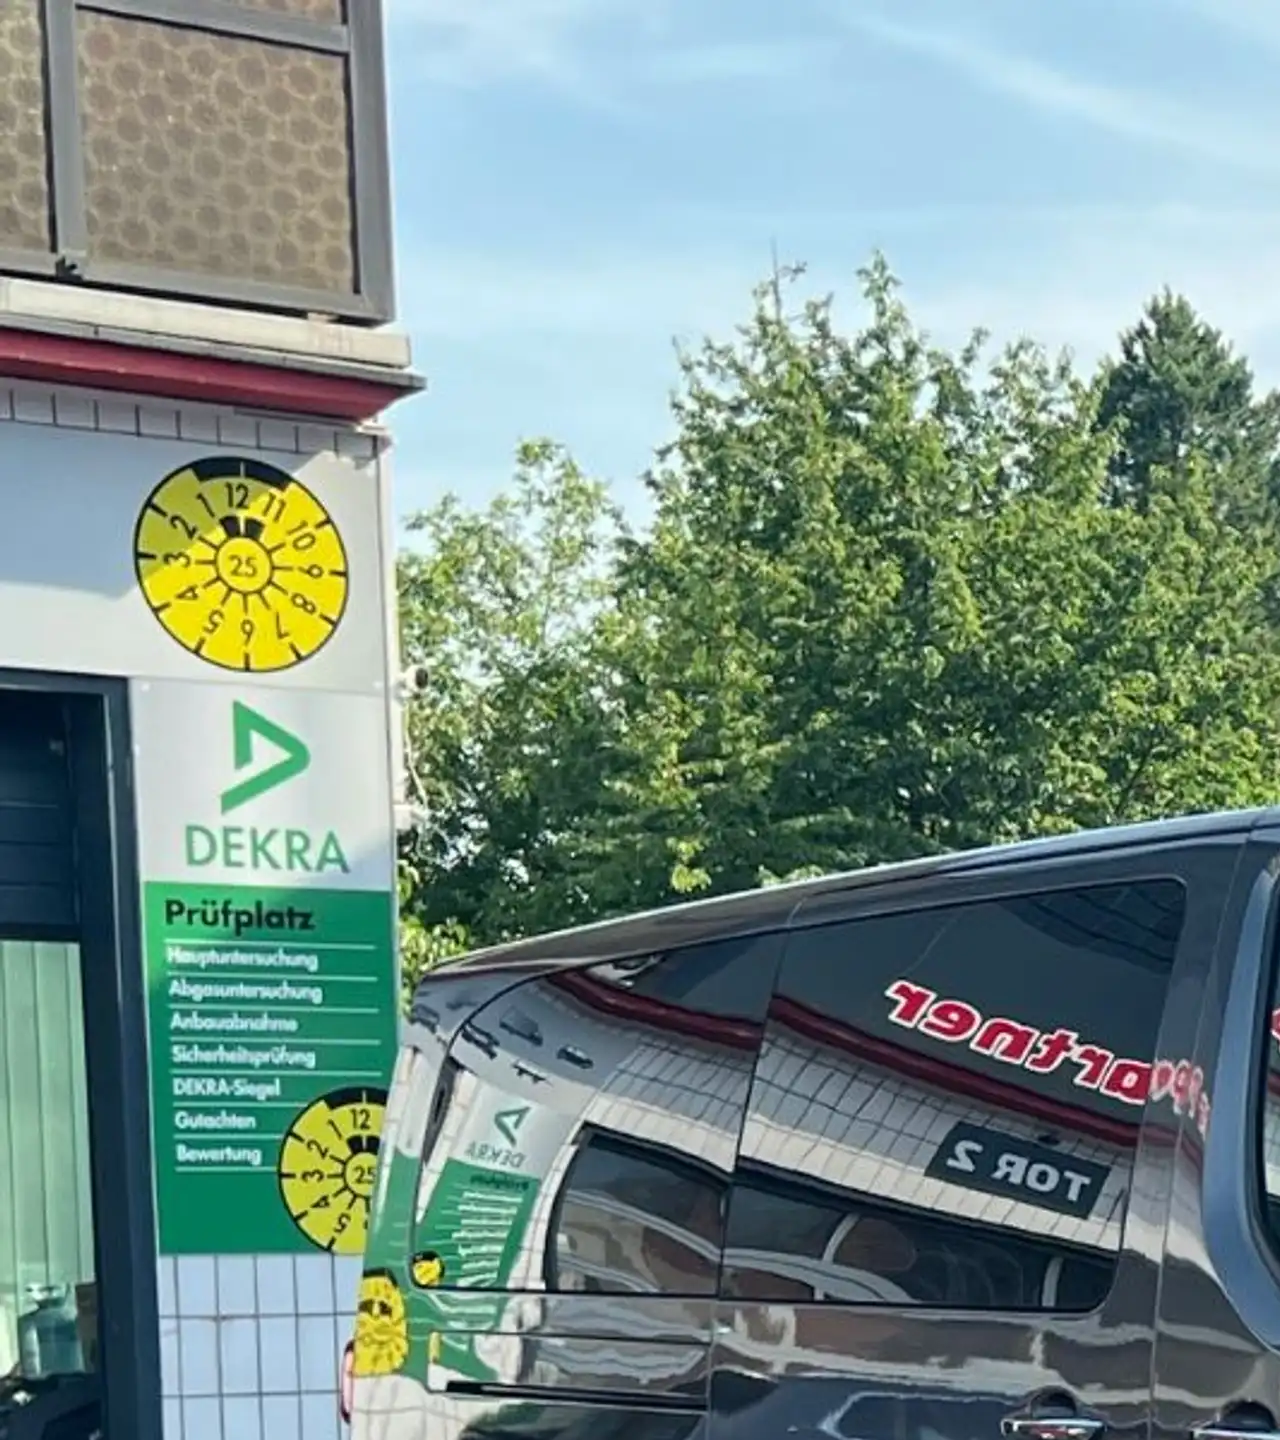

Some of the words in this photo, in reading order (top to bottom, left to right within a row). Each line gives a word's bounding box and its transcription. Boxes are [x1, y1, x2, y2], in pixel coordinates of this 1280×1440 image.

[196, 493, 217, 519] 1
[225, 482, 250, 510] 12
[263, 492, 287, 522] 11
[170, 512, 199, 541] 2
[286, 518, 318, 552] 10
[163, 545, 192, 568] 3
[229, 554, 259, 579] 25
[301, 563, 325, 579] 9
[176, 586, 200, 602] 4
[290, 592, 318, 616] 8
[201, 608, 226, 635] 5
[239, 618, 254, 644] 6
[273, 611, 291, 640] 7
[185, 824, 350, 873] DEKRA
[164, 898, 316, 936] Prüfplatz
[167, 945, 319, 972] Hauptuntersuchung
[169, 978, 323, 1004] Abgasuntersuchung
[170, 1011, 299, 1032] Anbauabnahme
[171, 1043, 317, 1069] Sicherheitsprüfung
[172, 1077, 281, 1101] DEKRA-Siegel
[174, 1109, 257, 1129] Gutachten
[349, 1108, 371, 1131] 12
[175, 1143, 262, 1166] Bewertung
[306, 1139, 329, 1160] 2
[301, 1168, 325, 1182] 3
[352, 1165, 377, 1185] 25
[310, 1195, 331, 1209] 4
[333, 1212, 352, 1235] 5
